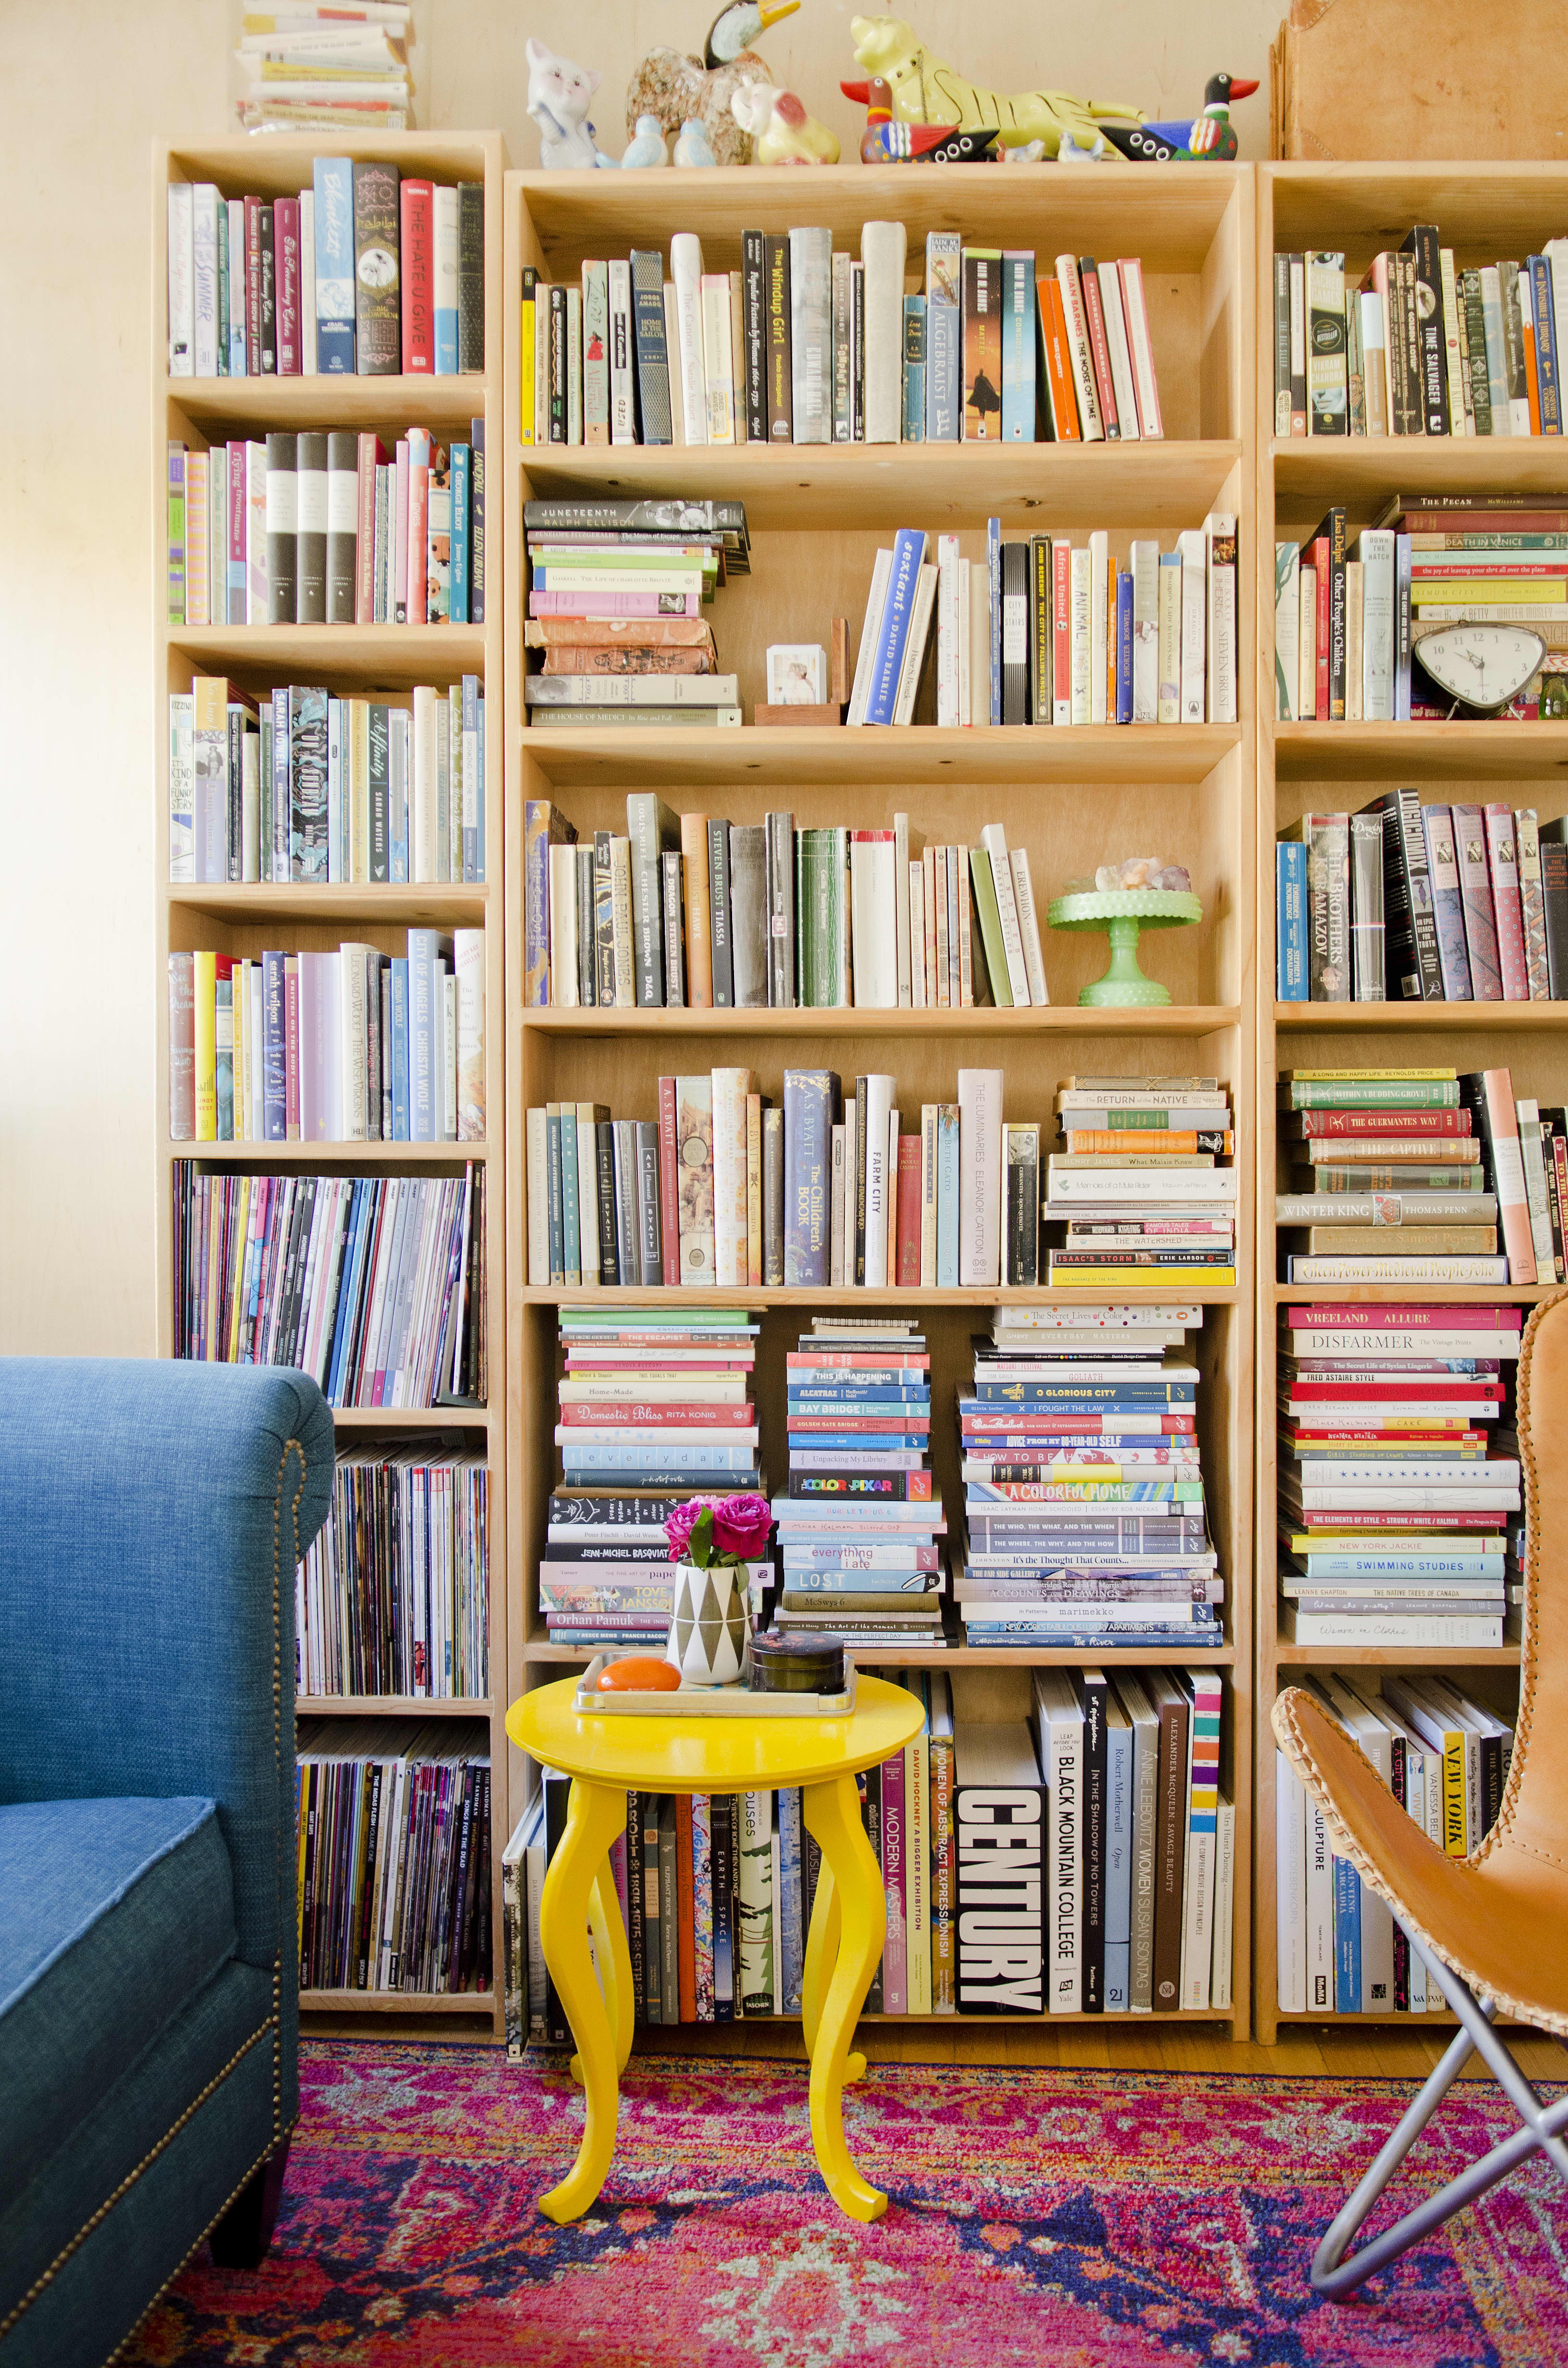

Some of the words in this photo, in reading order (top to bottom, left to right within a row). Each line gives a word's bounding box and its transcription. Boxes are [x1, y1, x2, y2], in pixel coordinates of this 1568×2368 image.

[411, 203, 425, 233] THE
[284, 236, 295, 255] The
[774, 248, 784, 266] The
[411, 239, 425, 284] HATE
[252, 290, 257, 299] TO
[282, 257, 295, 306] Secondary
[413, 288, 425, 298] U
[748, 271, 758, 300] Popular
[770, 268, 784, 315] Windup
[1065, 262, 1077, 296] JULIAN
[1071, 300, 1084, 338] BARNES
[252, 323, 257, 332] UP
[283, 308, 295, 337] Colors
[412, 304, 425, 344] GIVE
[750, 302, 760, 328] Fiction
[749, 330, 760, 338] by
[773, 318, 785, 345] Girl
[1425, 327, 1437, 349] TIME
[751, 339, 760, 366] Women
[934, 312, 946, 402] ALGEBRAIST
[1078, 342, 1087, 357] THE
[1079, 359, 1091, 383] NOISE
[1426, 354, 1441, 405] SALVAGER
[1085, 385, 1093, 396] OF
[1087, 399, 1096, 419] TIME
[473, 450, 485, 494] LANDFALL
[541, 509, 616, 517] JUNETEENTH
[474, 525, 483, 555] ELLEN
[474, 555, 484, 591] URBANI
[893, 541, 913, 611] sextant
[1057, 550, 1066, 583] Africa
[1334, 572, 1344, 600] Other
[1057, 585, 1066, 617] United
[1333, 601, 1343, 635] People's
[886, 624, 899, 659] DAVID
[1433, 645, 1444, 654] 10
[1453, 636, 1463, 645] 11
[1472, 633, 1484, 642] 12
[1334, 637, 1343, 676] Children
[1521, 663, 1527, 671] 3
[879, 662, 893, 701] BARRIE
[1449, 678, 1456, 687] 8
[1464, 690, 1470, 698] 7
[1499, 689, 1505, 697] 5
[1510, 678, 1517, 686] 4
[1482, 693, 1488, 702] 6
[301, 734, 319, 748] ON
[370, 713, 388, 778] Affinity
[301, 768, 319, 815] SUNBEAM
[375, 791, 383, 818] SARAH
[1400, 791, 1427, 871] LOGICOMIX
[713, 830, 723, 870] STEVEN
[640, 870, 649, 923] CHESTER
[714, 874, 723, 906] BRUST
[715, 910, 725, 947] TIASSA
[416, 936, 427, 960] CITY
[643, 927, 651, 966] BROWN
[270, 960, 280, 988] sarah
[416, 963, 427, 976] OF
[416, 979, 428, 1023] ANGELS
[645, 975, 653, 1001] D&Q
[270, 990, 281, 1024] wilson
[417, 1030, 428, 1076] CHRISTA
[417, 1079, 429, 1111] WOLF
[664, 1089, 672, 1099] A.
[664, 1114, 673, 1147] BYATT
[810, 1164, 821, 1184] The
[872, 1151, 882, 1185] FARM
[797, 1185, 809, 1227] BOOK
[872, 1188, 882, 1214] CITY
[1283, 1204, 1334, 1216] WINTER
[1336, 1204, 1370, 1216] KING
[1404, 1205, 1443, 1214] THOMAS
[1444, 1205, 1468, 1214] PENN
[810, 1185, 823, 1252] Children's
[1031, 1311, 1045, 1320] The
[1047, 1311, 1069, 1320] Secret
[1072, 1311, 1091, 1320] Lives
[1093, 1311, 1101, 1320] of
[1306, 1313, 1368, 1323] VREELAND
[1384, 1313, 1431, 1323] ALLURE
[1311, 1335, 1414, 1349] DISFARMER
[1069, 1373, 1103, 1381] GOLIATH
[1094, 1389, 1116, 1397] CITY
[577, 1404, 628, 1420] Domestic
[633, 1406, 663, 1420] Bliss
[799, 1405, 820, 1413] BAY
[821, 1405, 859, 1414] BRIDGE
[581, 1548, 632, 1557] JEAN-MICHEL
[633, 1548, 668, 1558] BASQUIAT
[812, 1548, 873, 1558] everything
[845, 1559, 848, 1567] i
[852, 1560, 870, 1568] ate
[1356, 1561, 1414, 1570] SWIMMING
[1419, 1562, 1464, 1571] STUDIES
[800, 1574, 845, 1587] LOST
[556, 1614, 593, 1626] Orhan
[595, 1614, 634, 1626] Pamuk
[1115, 1748, 1125, 1778] Robert
[1446, 1742, 1461, 1790] NEW
[1058, 1757, 1075, 1806] BLACK
[1114, 1781, 1124, 1833] Motherwell
[1447, 1793, 1463, 1846] YORK
[886, 1807, 900, 1873] MODERN
[1059, 1811, 1075, 1887] MOUNTAIN
[887, 1876, 901, 1939] MASTERS
[957, 1789, 1042, 2011] CENTURY
[1058, 1891, 1075, 1959] COLLEGE
[1317, 1977, 1325, 2003] MoMA
